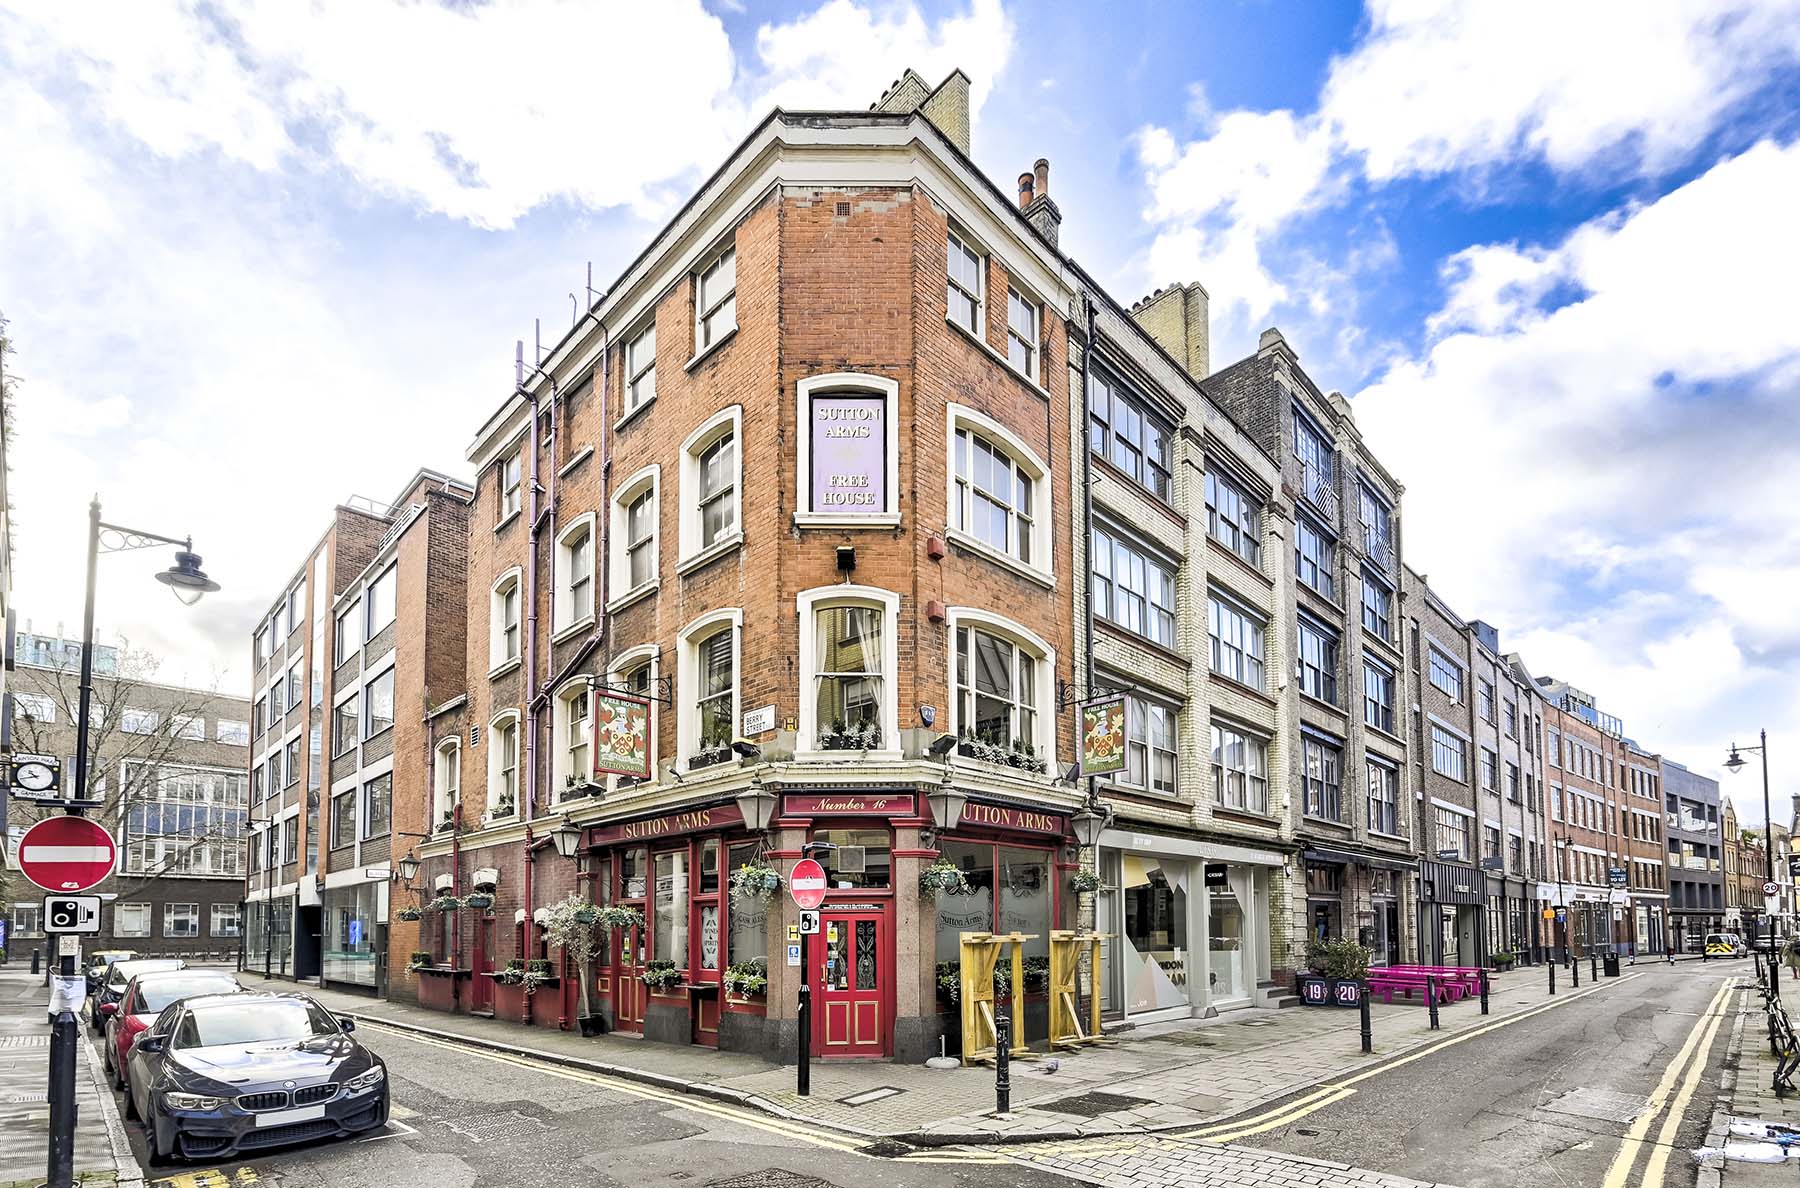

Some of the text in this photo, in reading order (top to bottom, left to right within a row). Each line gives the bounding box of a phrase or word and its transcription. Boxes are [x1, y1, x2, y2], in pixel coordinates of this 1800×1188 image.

[818, 407, 881, 421] SUTTON
[825, 425, 870, 439] ARMS
[829, 474, 869, 488] FREE
[823, 492, 875, 505] HOUSE
[1101, 701, 1119, 710] HOUSE
[746, 713, 763, 726] BERRY
[746, 721, 766, 735] STREET
[599, 760, 645, 773] SUTTON ARMS
[812, 798, 888, 811] Number 16
[962, 802, 1054, 832] UTTON ARMS
[625, 810, 711, 839] SUTTON ARMS
[939, 911, 983, 927] Sutton Arms
[788, 927, 799, 939] H
[1309, 984, 1321, 999] 19
[1340, 985, 1356, 1001] 20
